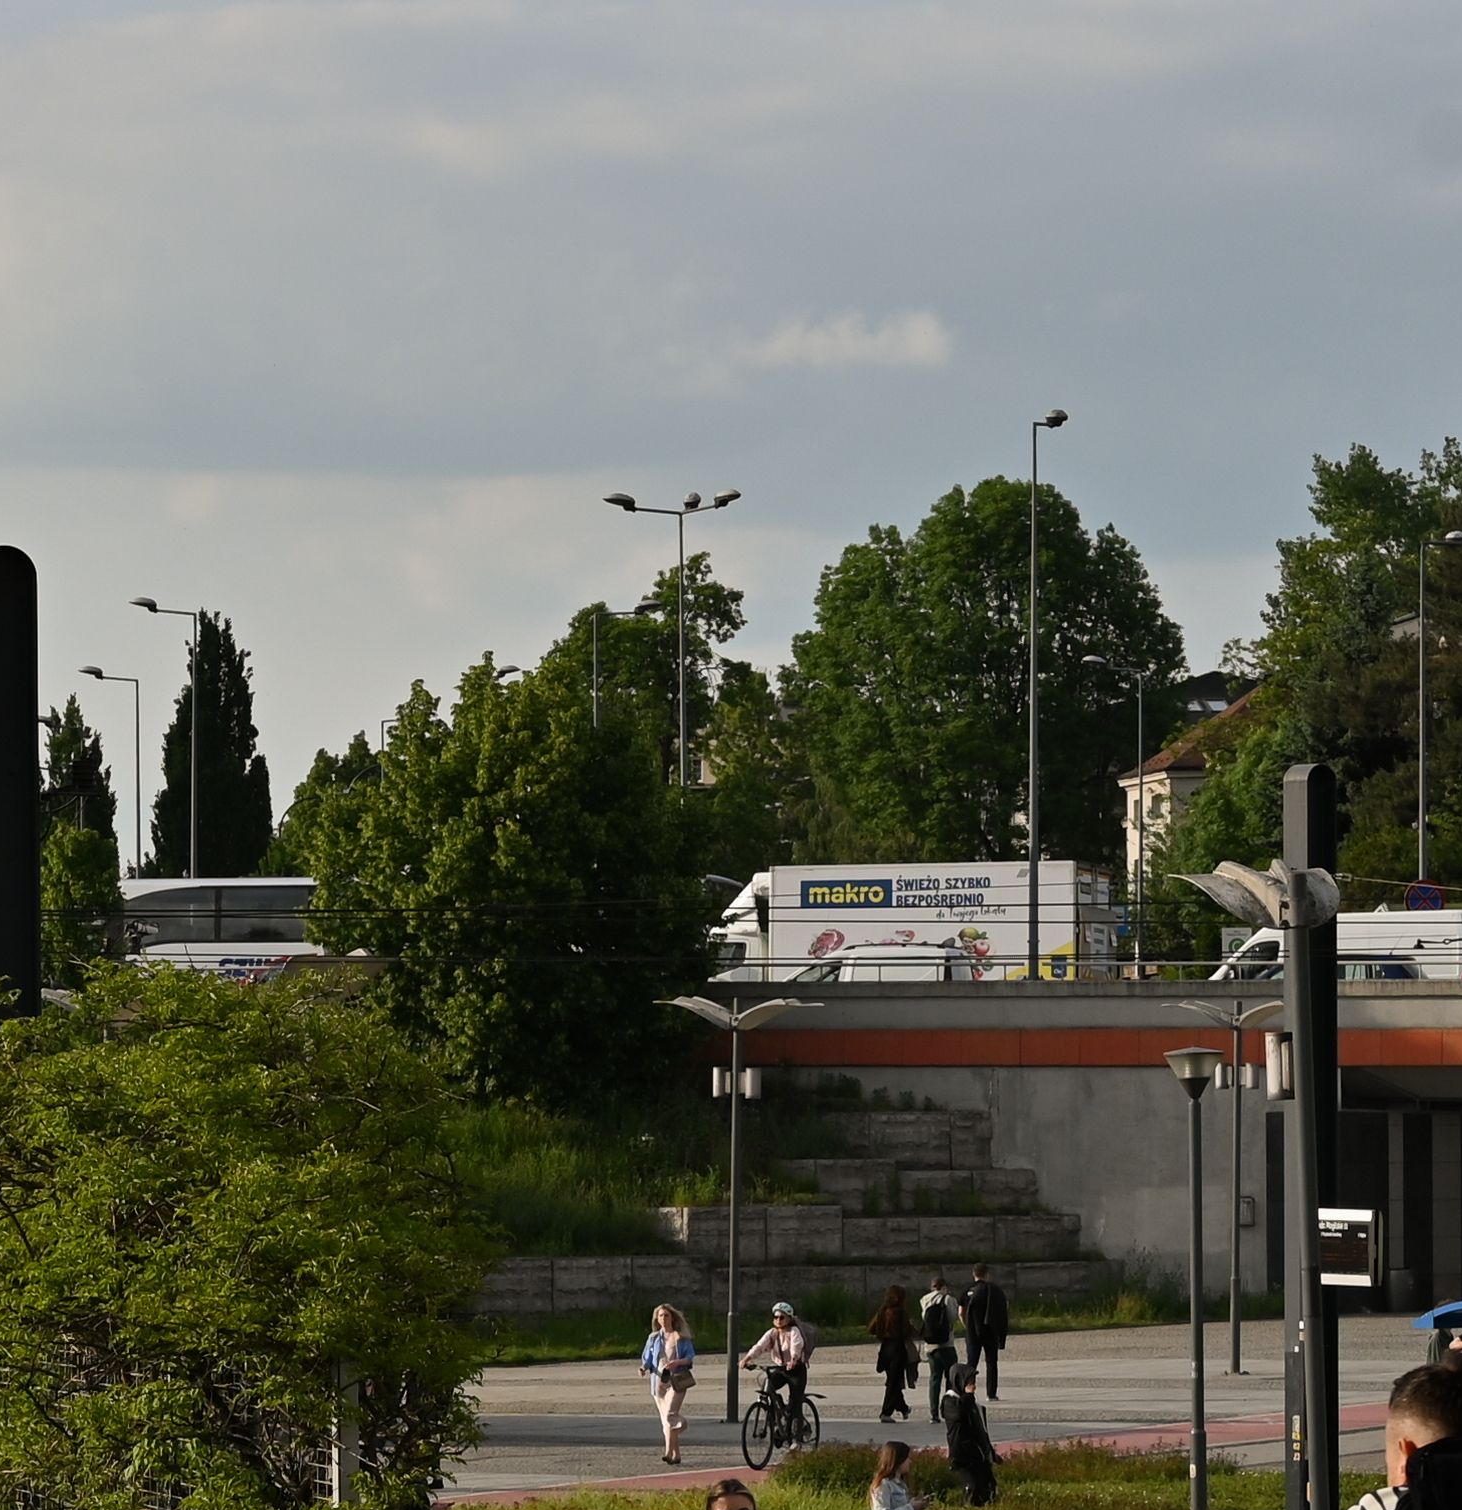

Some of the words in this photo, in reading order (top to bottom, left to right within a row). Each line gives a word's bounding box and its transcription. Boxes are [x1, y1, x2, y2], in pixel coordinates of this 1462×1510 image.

[896, 875, 939, 890] ŚWIEŻO
[945, 877, 991, 889] SZYBKO
[809, 883, 885, 904] makro
[896, 890, 984, 906] BEZPOŚREDNIO
